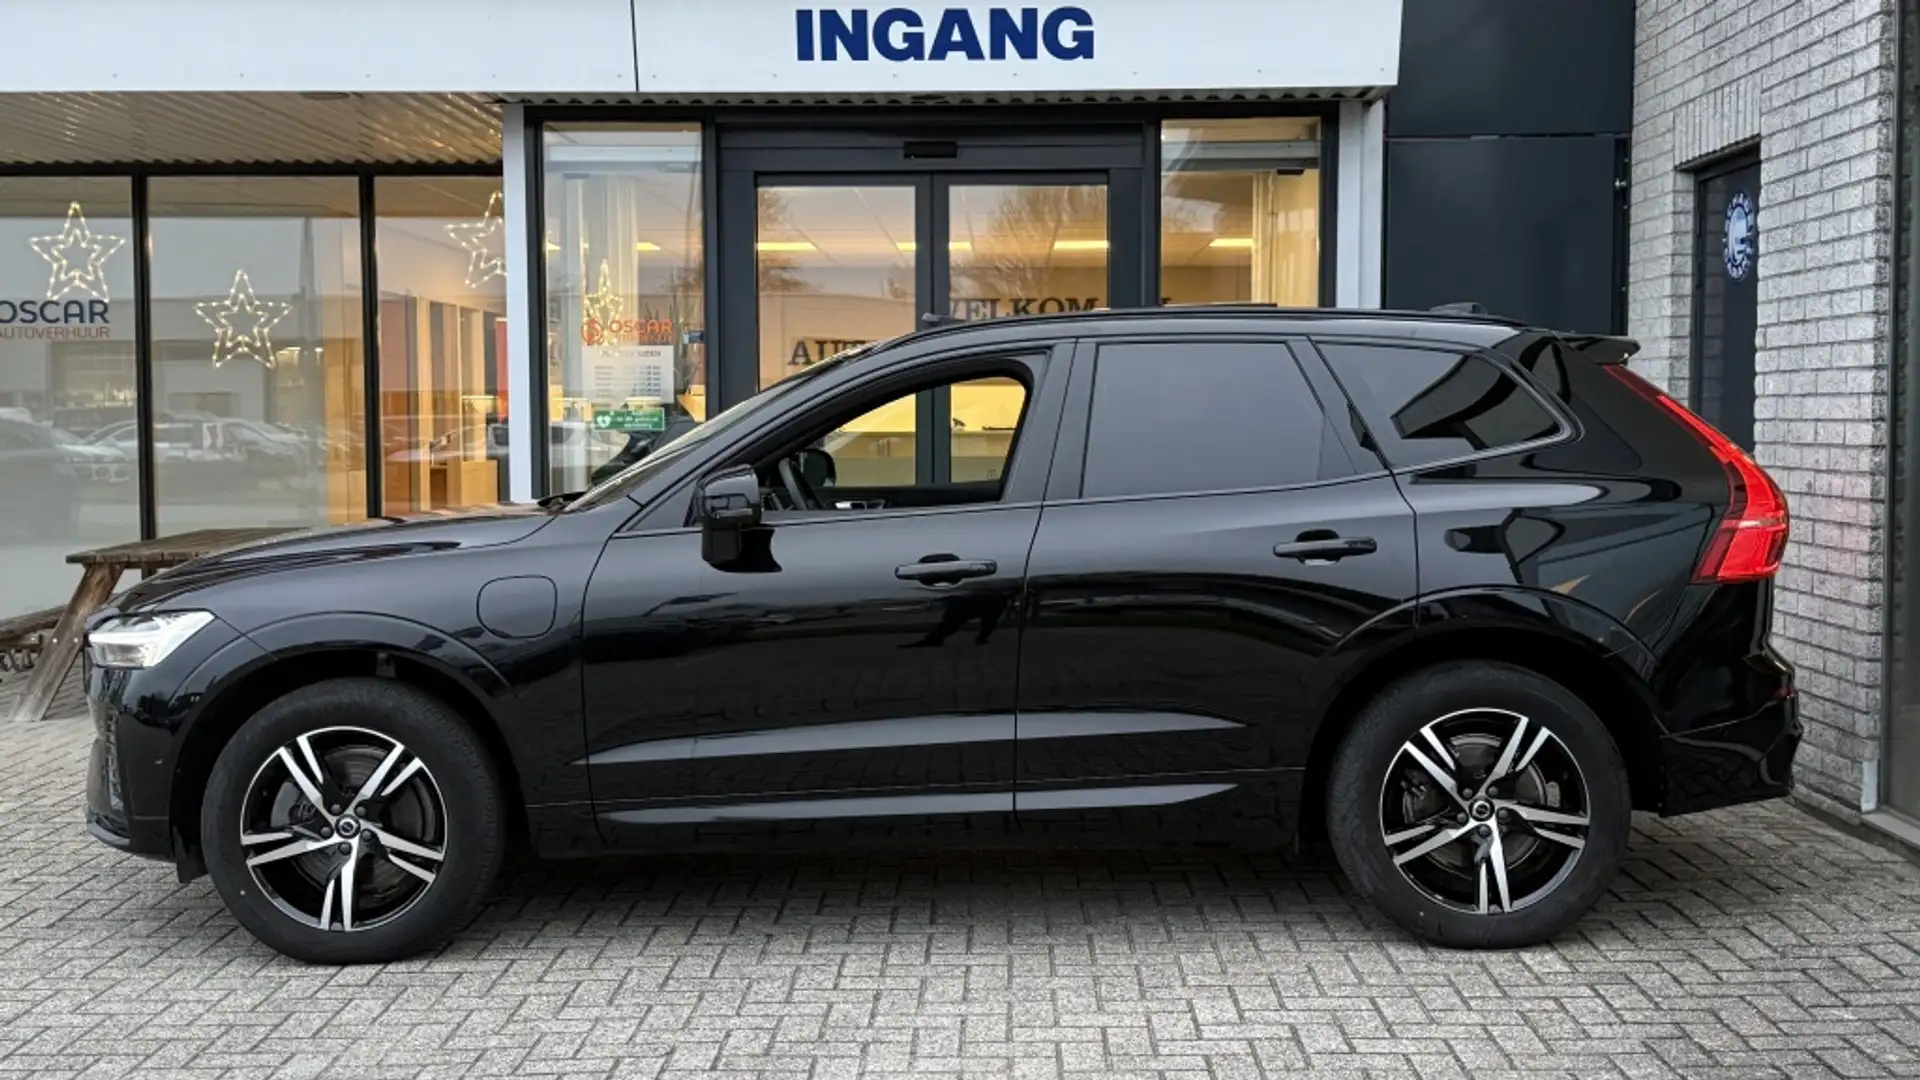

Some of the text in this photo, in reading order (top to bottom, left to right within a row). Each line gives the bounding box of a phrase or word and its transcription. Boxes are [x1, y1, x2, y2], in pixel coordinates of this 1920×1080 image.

[796, 8, 1094, 61] INGANG
[0, 300, 109, 324] OSCAR
[610, 319, 672, 333] OSCAR
